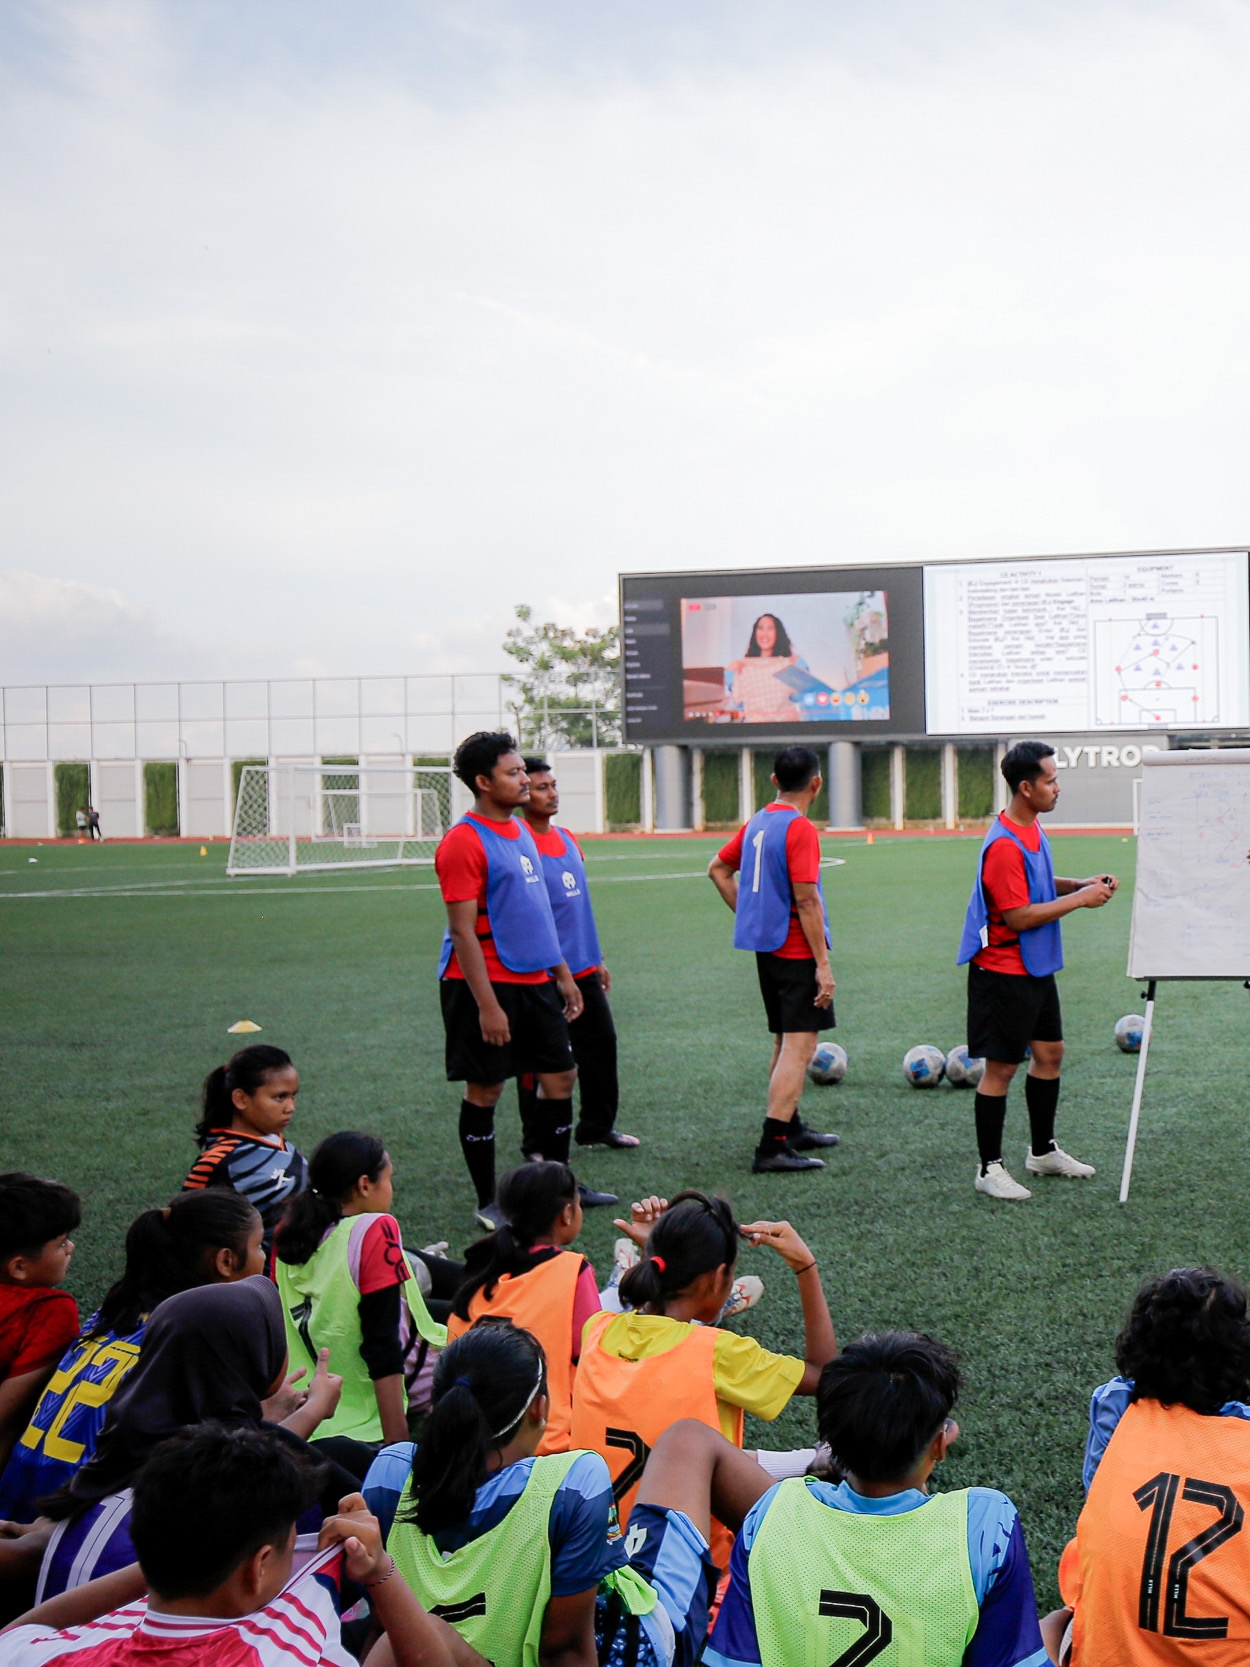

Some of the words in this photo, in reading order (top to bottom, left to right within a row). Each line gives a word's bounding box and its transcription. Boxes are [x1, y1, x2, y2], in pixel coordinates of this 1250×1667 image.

[1054, 744, 1160, 769] LYTRO
[752, 830, 765, 893] 1
[20, 1335, 141, 1464] 22
[1132, 1471, 1245, 1640] 12
